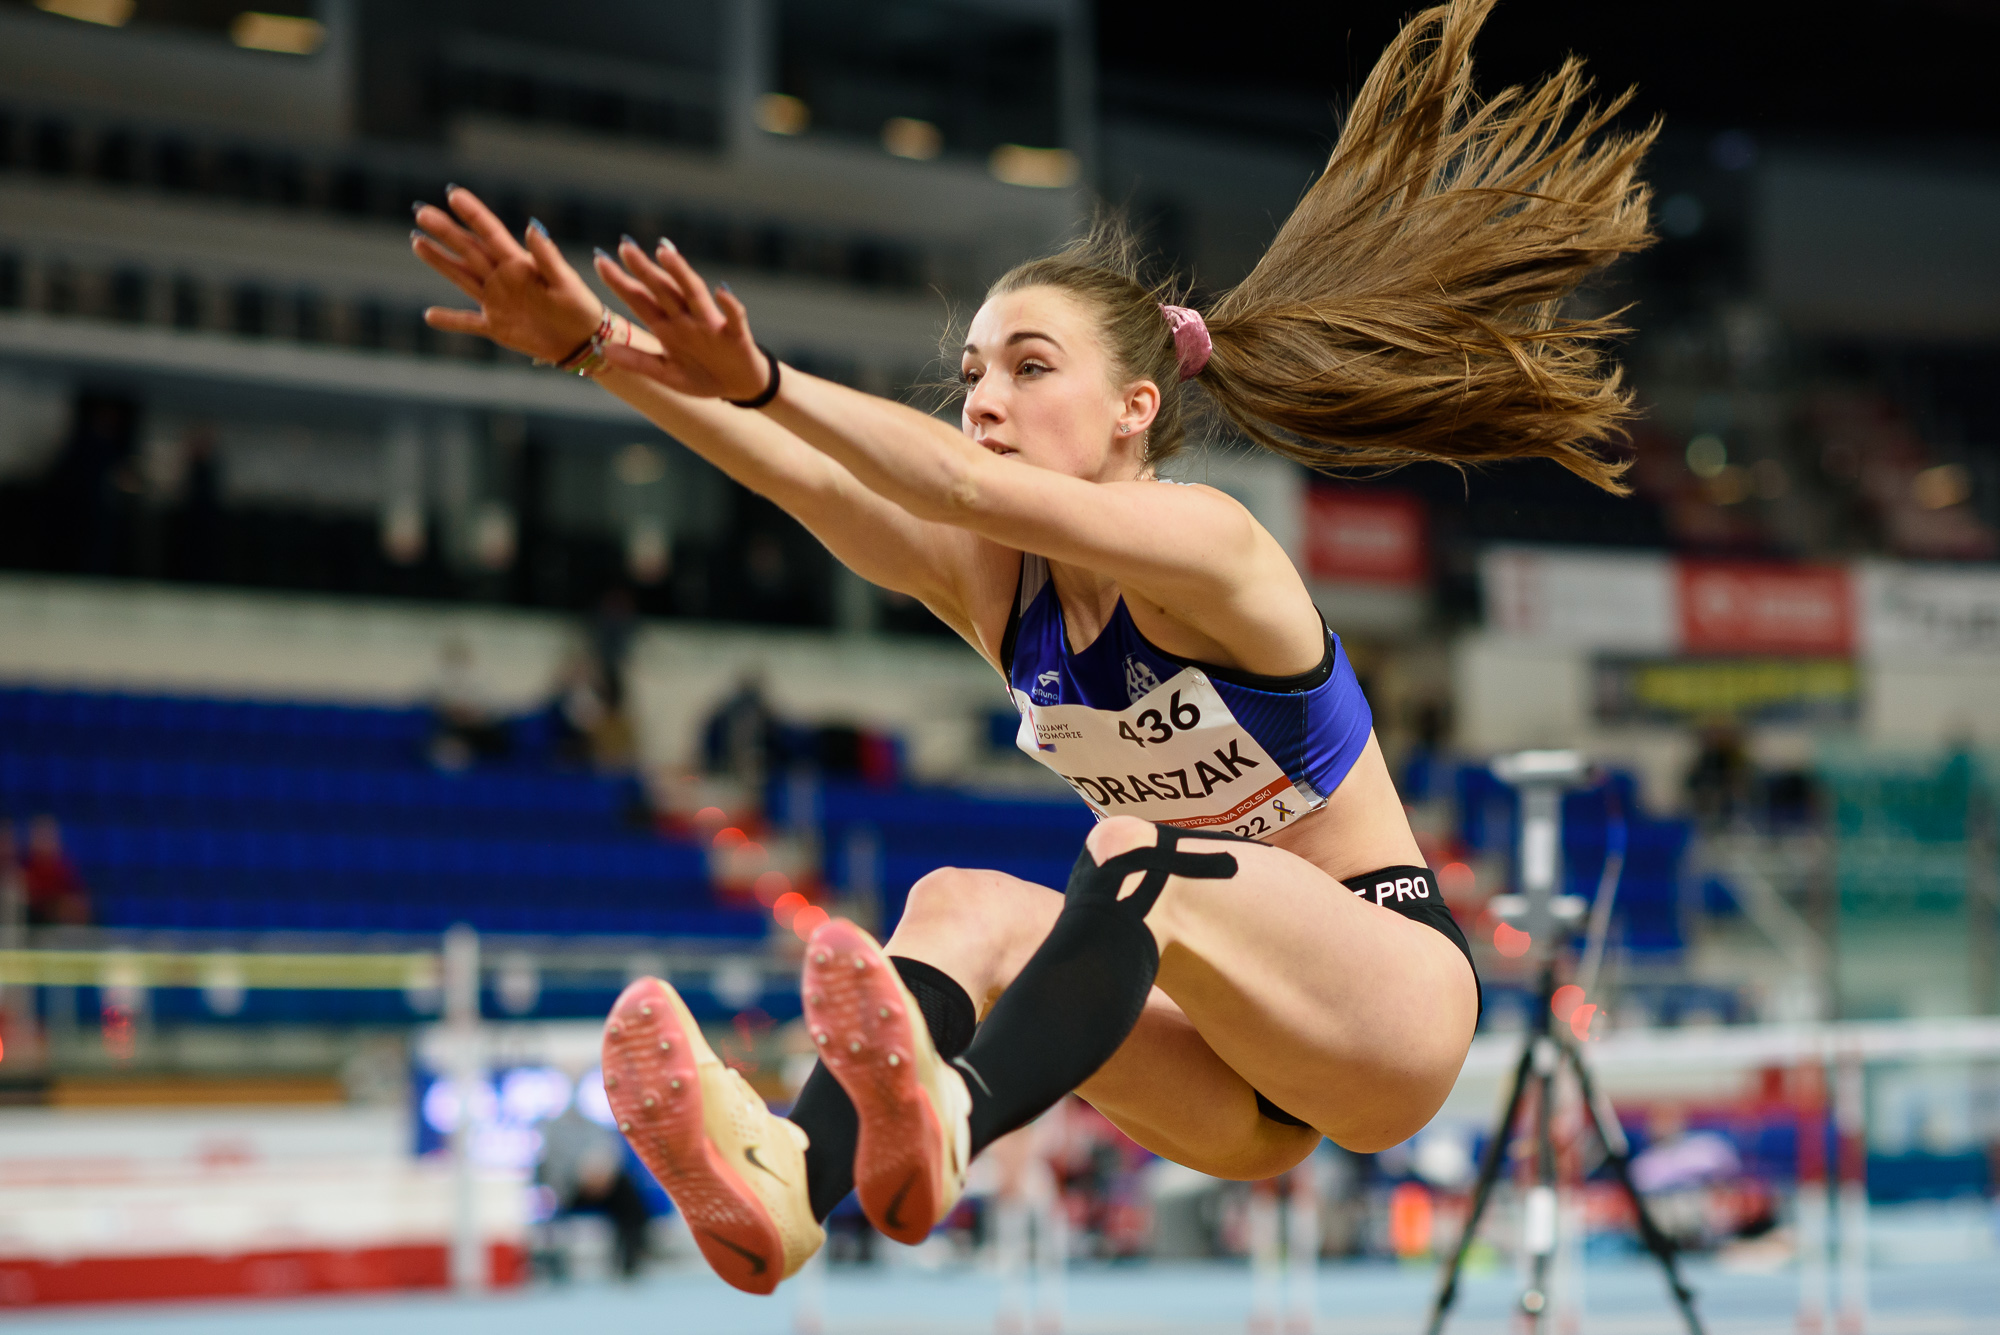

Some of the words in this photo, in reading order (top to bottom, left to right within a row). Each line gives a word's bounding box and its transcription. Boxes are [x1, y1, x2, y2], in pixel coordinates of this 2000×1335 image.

[1036, 724, 1069, 732] KUJAWY
[1119, 689, 1201, 749] 436
[1038, 731, 1083, 740] POMORZE
[1237, 789, 1272, 815] POLSKI
[1220, 816, 1272, 839] 22
[1376, 876, 1430, 907] PRO
